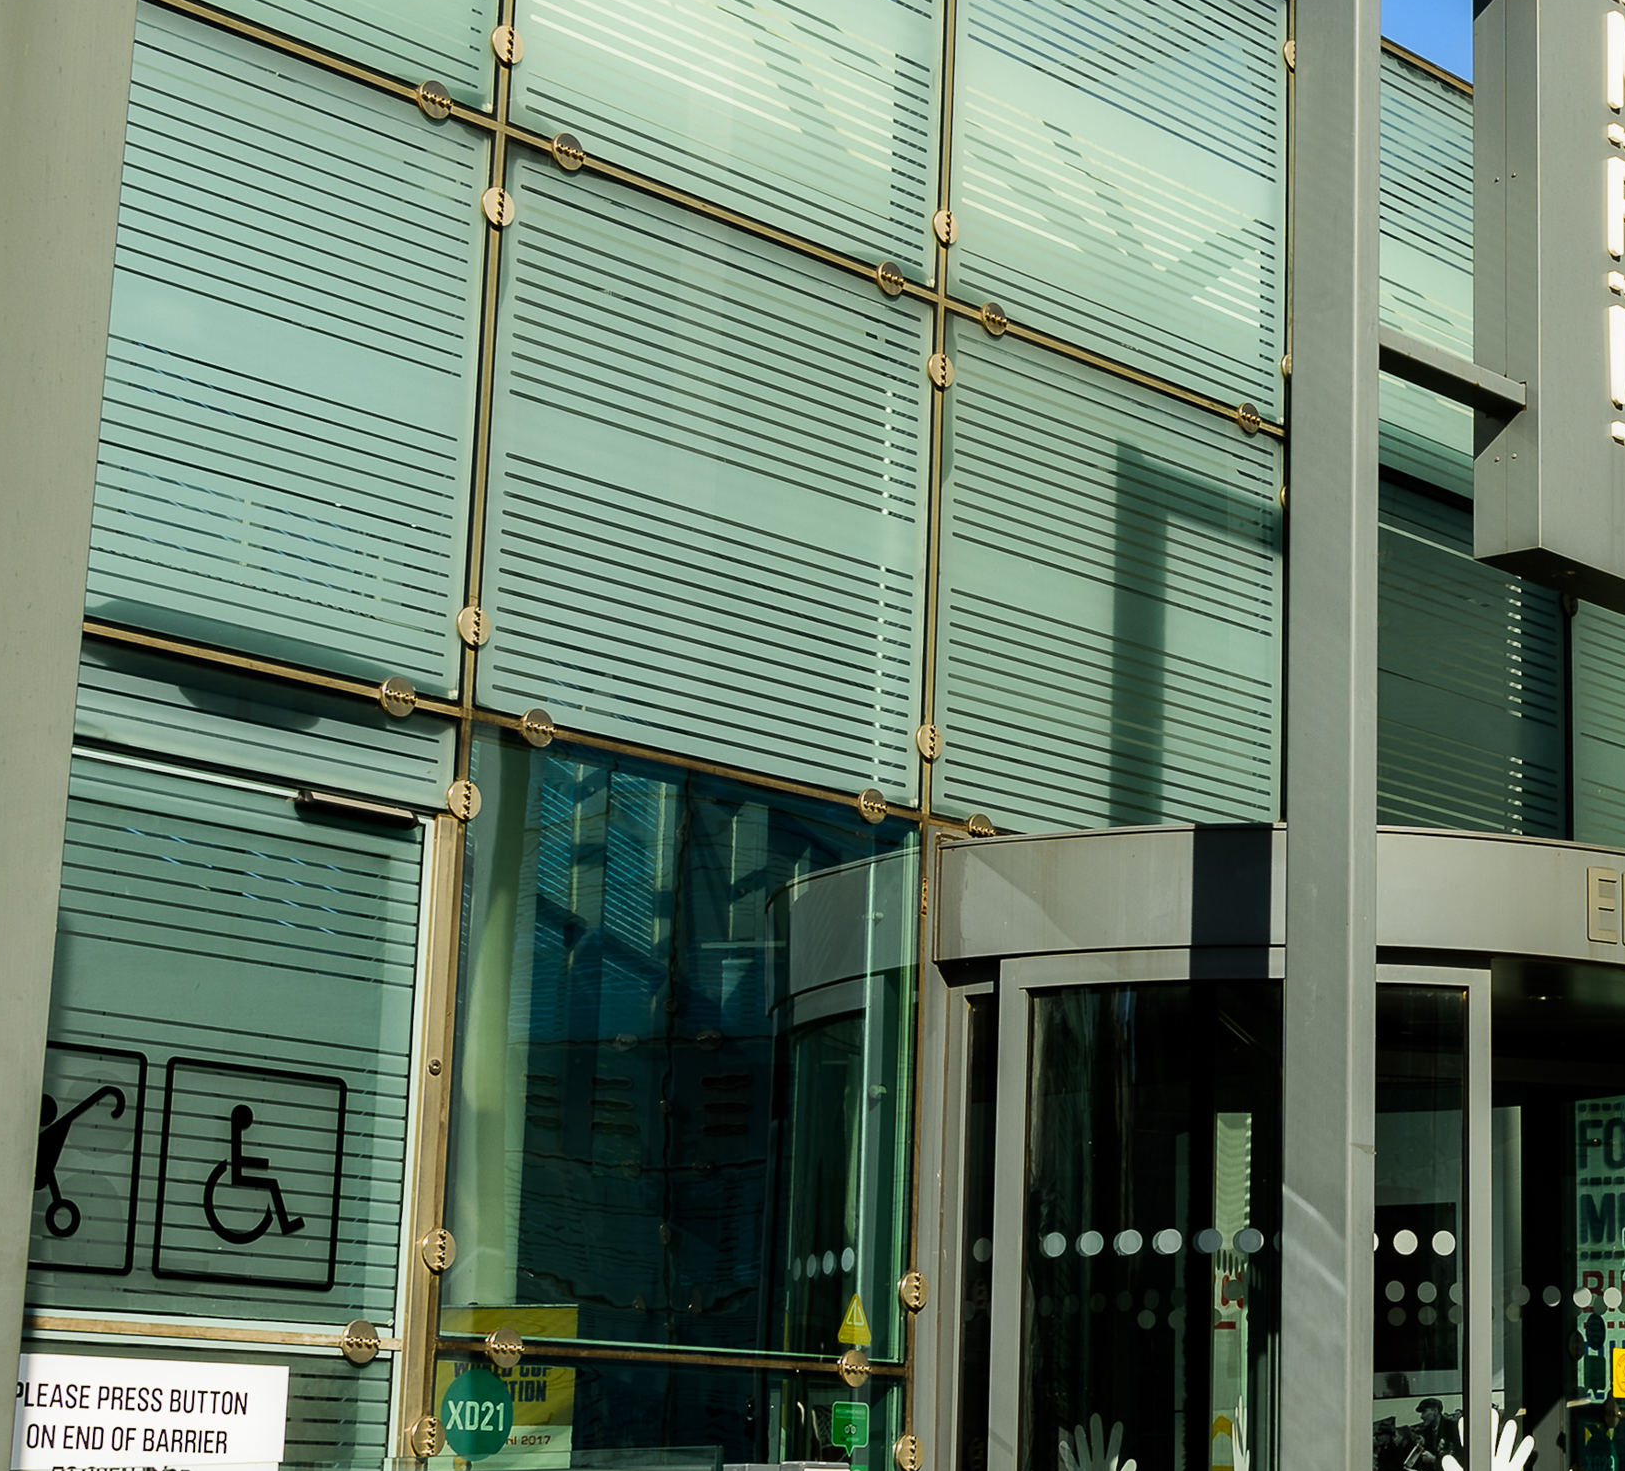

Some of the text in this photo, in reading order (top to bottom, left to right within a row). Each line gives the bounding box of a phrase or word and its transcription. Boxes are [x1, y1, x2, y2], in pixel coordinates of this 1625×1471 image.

[97, 1385, 163, 1412] PRESS
[169, 1389, 249, 1416] BUTTON
[446, 1400, 505, 1431] XD21
[26, 1423, 228, 1454] ON END OF BARRIER
[521, 1435, 551, 1446] 2017
